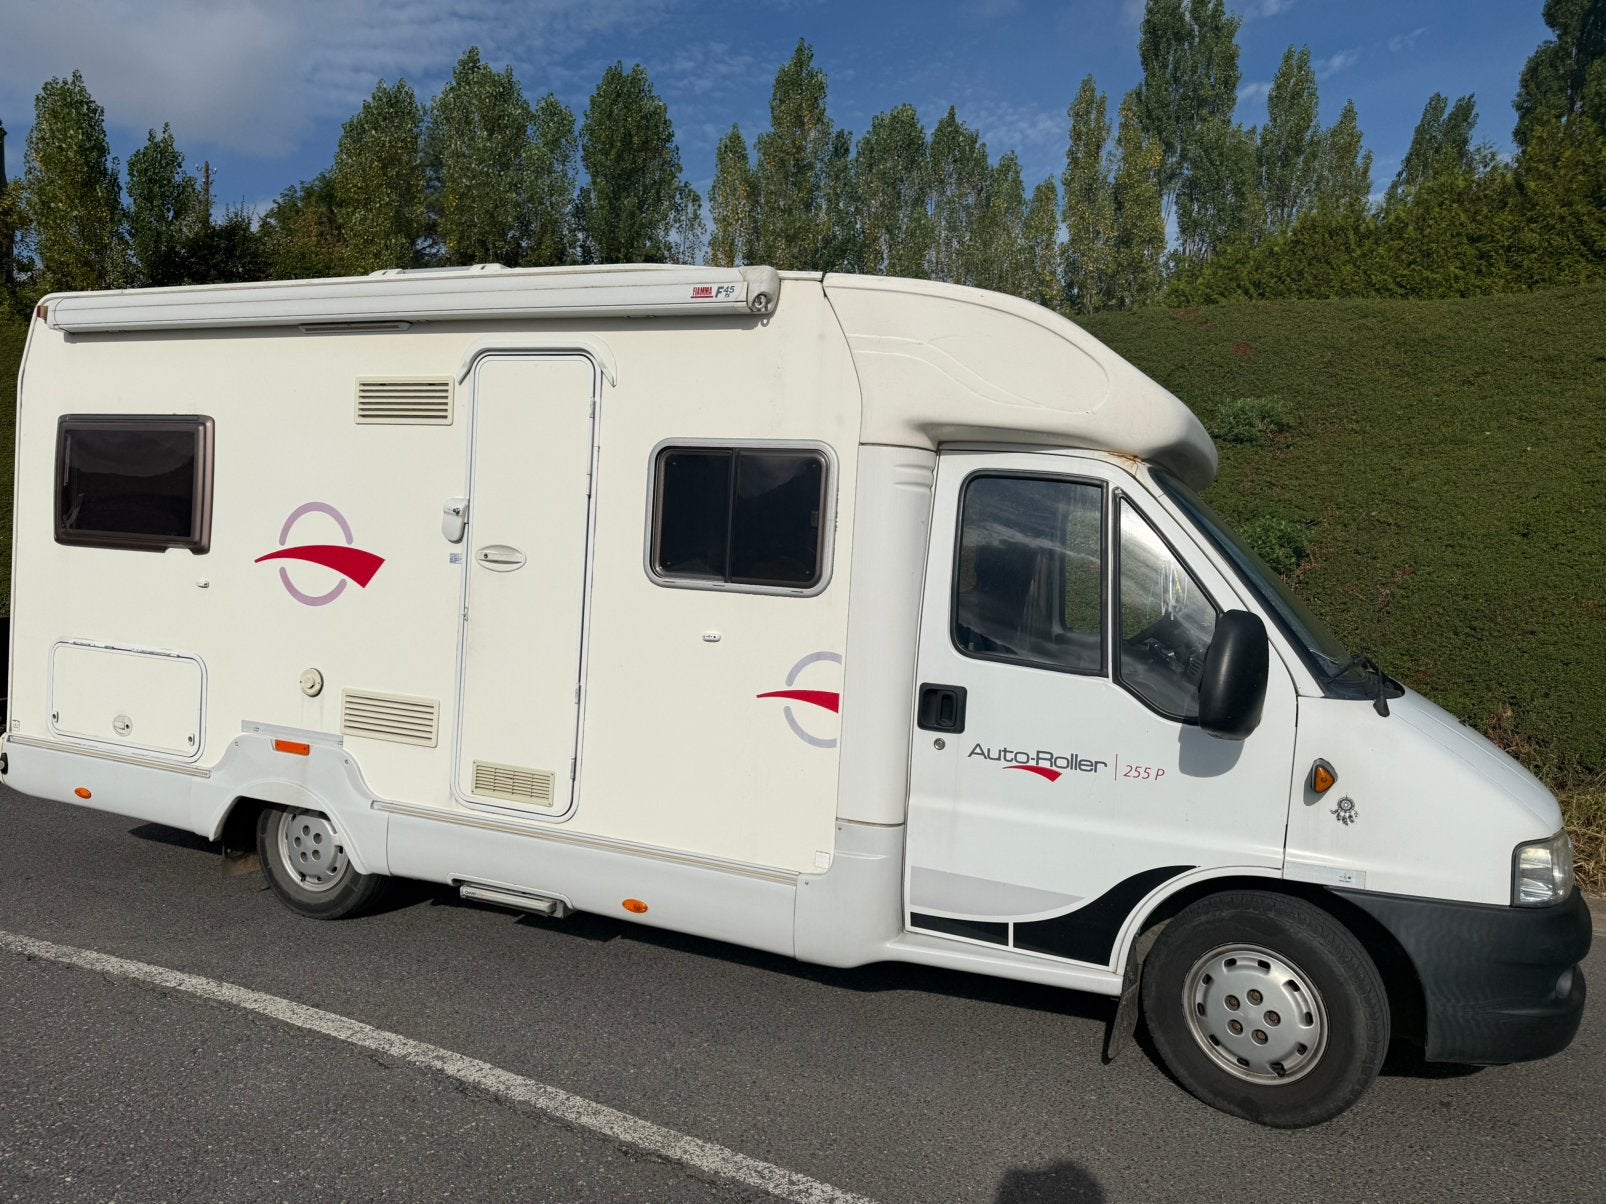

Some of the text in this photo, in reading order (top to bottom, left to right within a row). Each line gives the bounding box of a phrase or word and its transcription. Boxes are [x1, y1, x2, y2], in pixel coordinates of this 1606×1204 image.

[967, 743, 1165, 781] Auto-Roller 255 P
